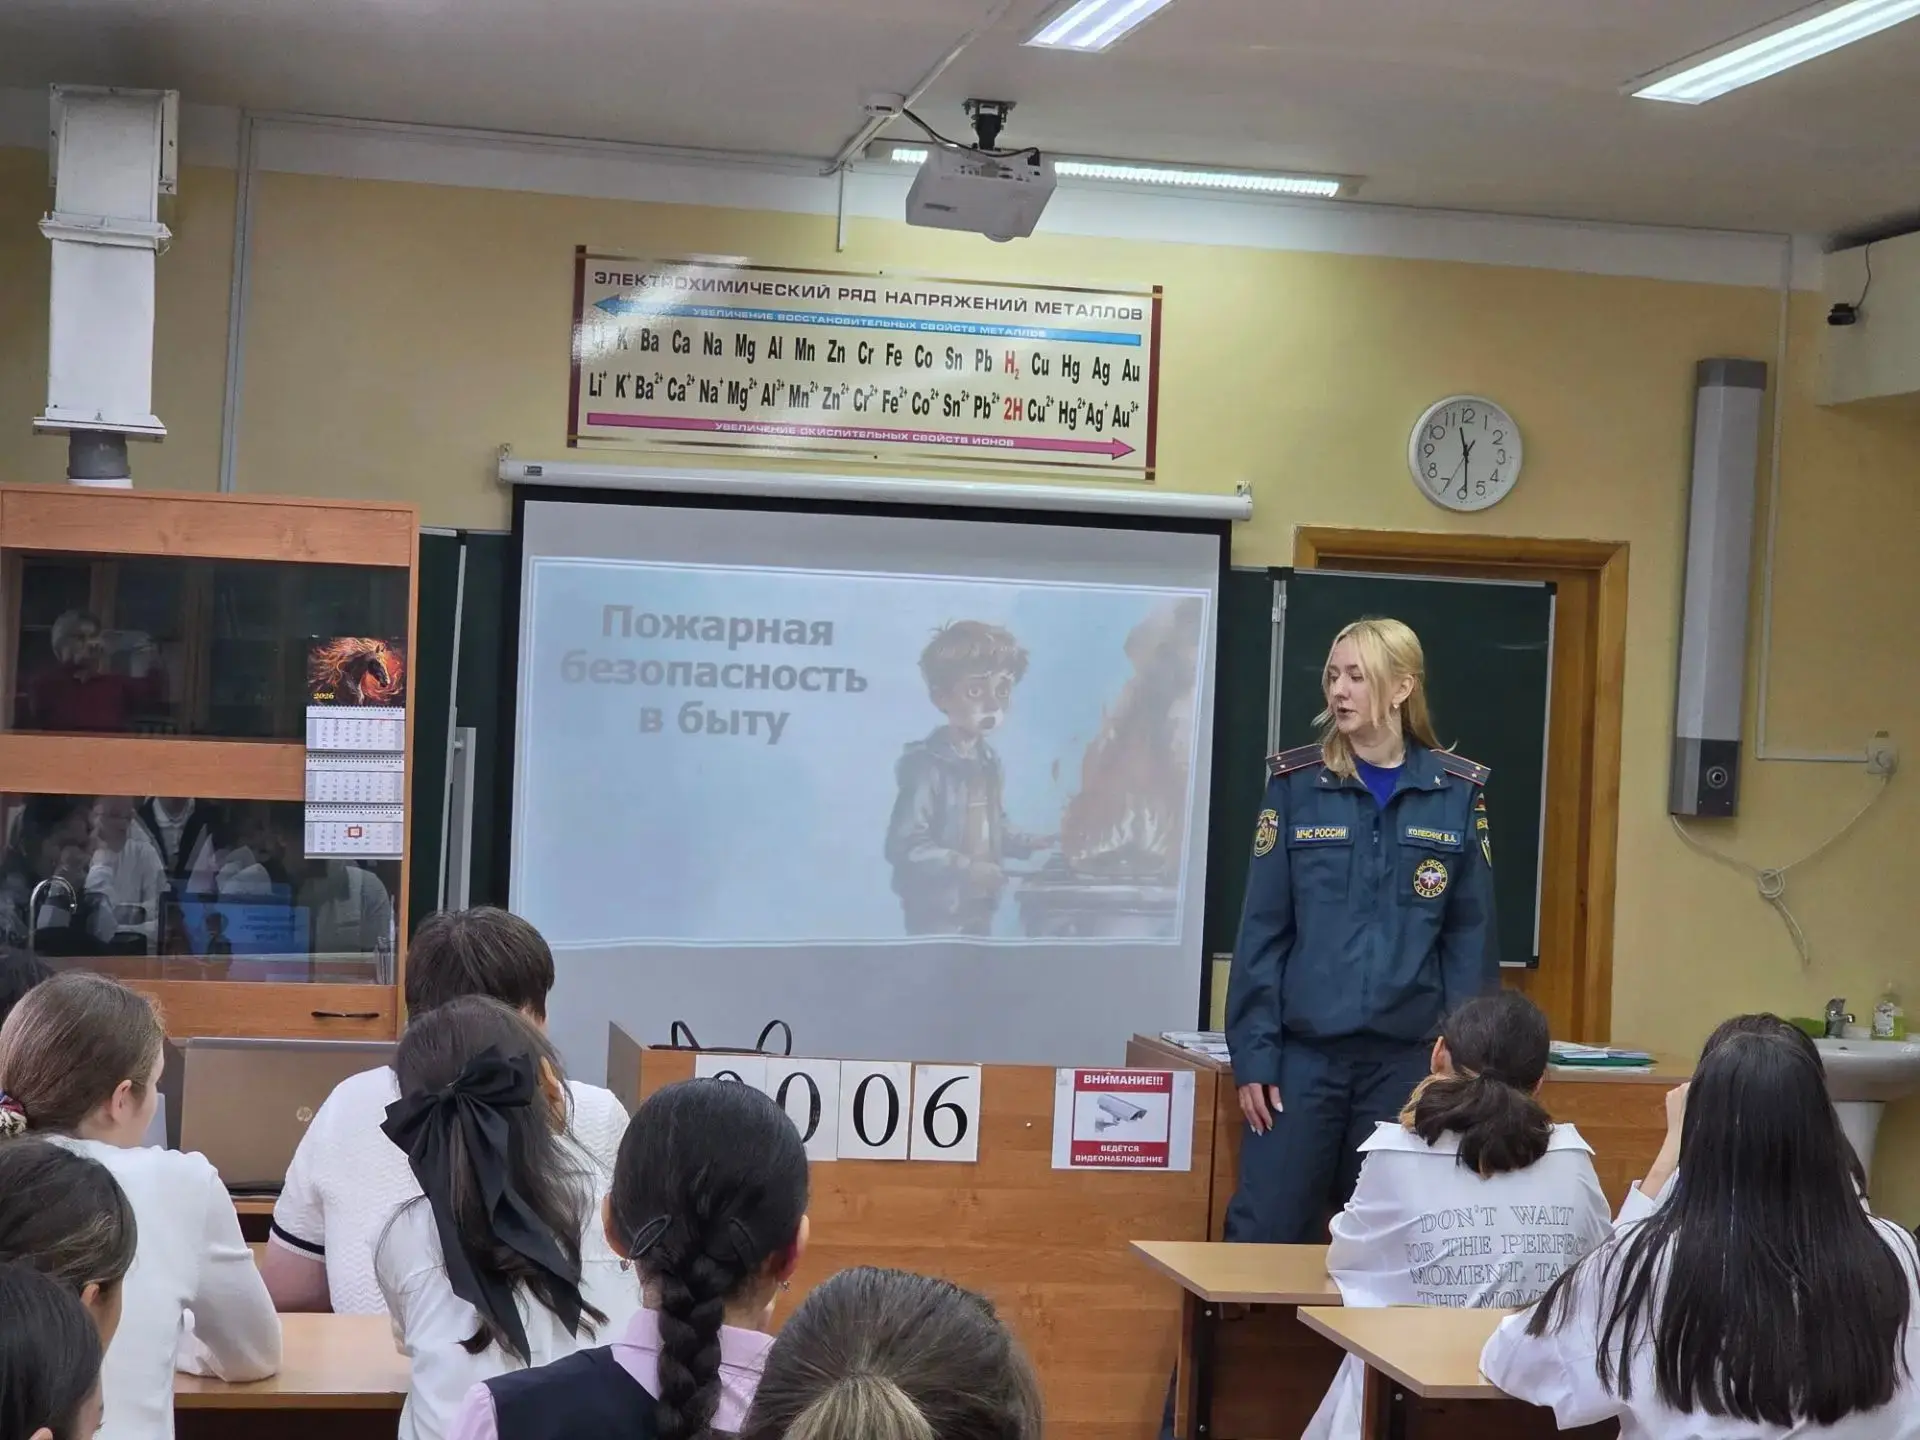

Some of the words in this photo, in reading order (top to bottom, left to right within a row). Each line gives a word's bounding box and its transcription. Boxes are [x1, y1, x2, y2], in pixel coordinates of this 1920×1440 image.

[838, 286, 877, 304] РЯД
[884, 290, 1028, 313] НАПРЯЖЕНИЙ
[1034, 299, 1143, 321] МЕТАЛЛОВ
[692, 307, 774, 321] УВЕЛИЧЕНИЕ
[779, 313, 917, 331] ВОССТАНОВИТЕЛЬНЫХ
[920, 321, 977, 335] СВОЙСТВ
[979, 325, 1047, 338] МЕТАЛЛОВ
[641, 328, 659, 352] Ba
[672, 329, 691, 354] Ca
[703, 331, 722, 356] Na
[735, 333, 756, 364] Mg
[767, 335, 783, 360] Al
[795, 337, 815, 362] Mn
[827, 339, 846, 363] Zn
[858, 341, 874, 364] Cr
[886, 343, 902, 367] Fe
[914, 344, 932, 368] Co
[944, 346, 962, 371] Sn
[975, 348, 992, 372] Pb
[1031, 352, 1049, 376] Cu
[1061, 354, 1080, 384] Hg
[1091, 356, 1110, 386] Ag
[1121, 359, 1140, 382] Au
[1444, 411, 1456, 428] 11
[1461, 407, 1476, 424] 12
[714, 421, 796, 436] УВЕЛИЧЕНИЕ
[800, 426, 909, 441] ОКИСЛИТЕЛЬНЫХ
[912, 431, 968, 445] СВОЙСТВ
[971, 437, 1014, 448] ИОНОВ
[1429, 424, 1446, 441] 10
[1491, 428, 1504, 446] 2
[1423, 443, 1435, 459] 9
[1496, 448, 1507, 465] 3
[1427, 461, 1438, 479] 8
[1489, 468, 1500, 483] 4
[1439, 476, 1450, 493] 7
[1456, 483, 1468, 500] 6
[1475, 480, 1486, 497] 5
[601, 603, 834, 651] Пожарная
[560, 648, 869, 693] безопасность
[313, 691, 335, 700] 2026
[639, 705, 664, 734] в
[677, 700, 791, 745] быту
[1296, 829, 1313, 839] МЧС
[1314, 827, 1346, 839] РОССИИ
[1083, 1074, 1164, 1086] ВНИМАНИЕ!!!
[709, 1069, 968, 1149] 006
[1075, 1154, 1164, 1164] ВИДЕОНАБЛЮДЕНИЕ
[1420, 1205, 1497, 1234] DON'T
[1511, 1205, 1575, 1226] WAIT
[1442, 1236, 1492, 1257] THE
[1410, 1261, 1526, 1286] MOMENT.
[1535, 1262, 1570, 1283] TA
